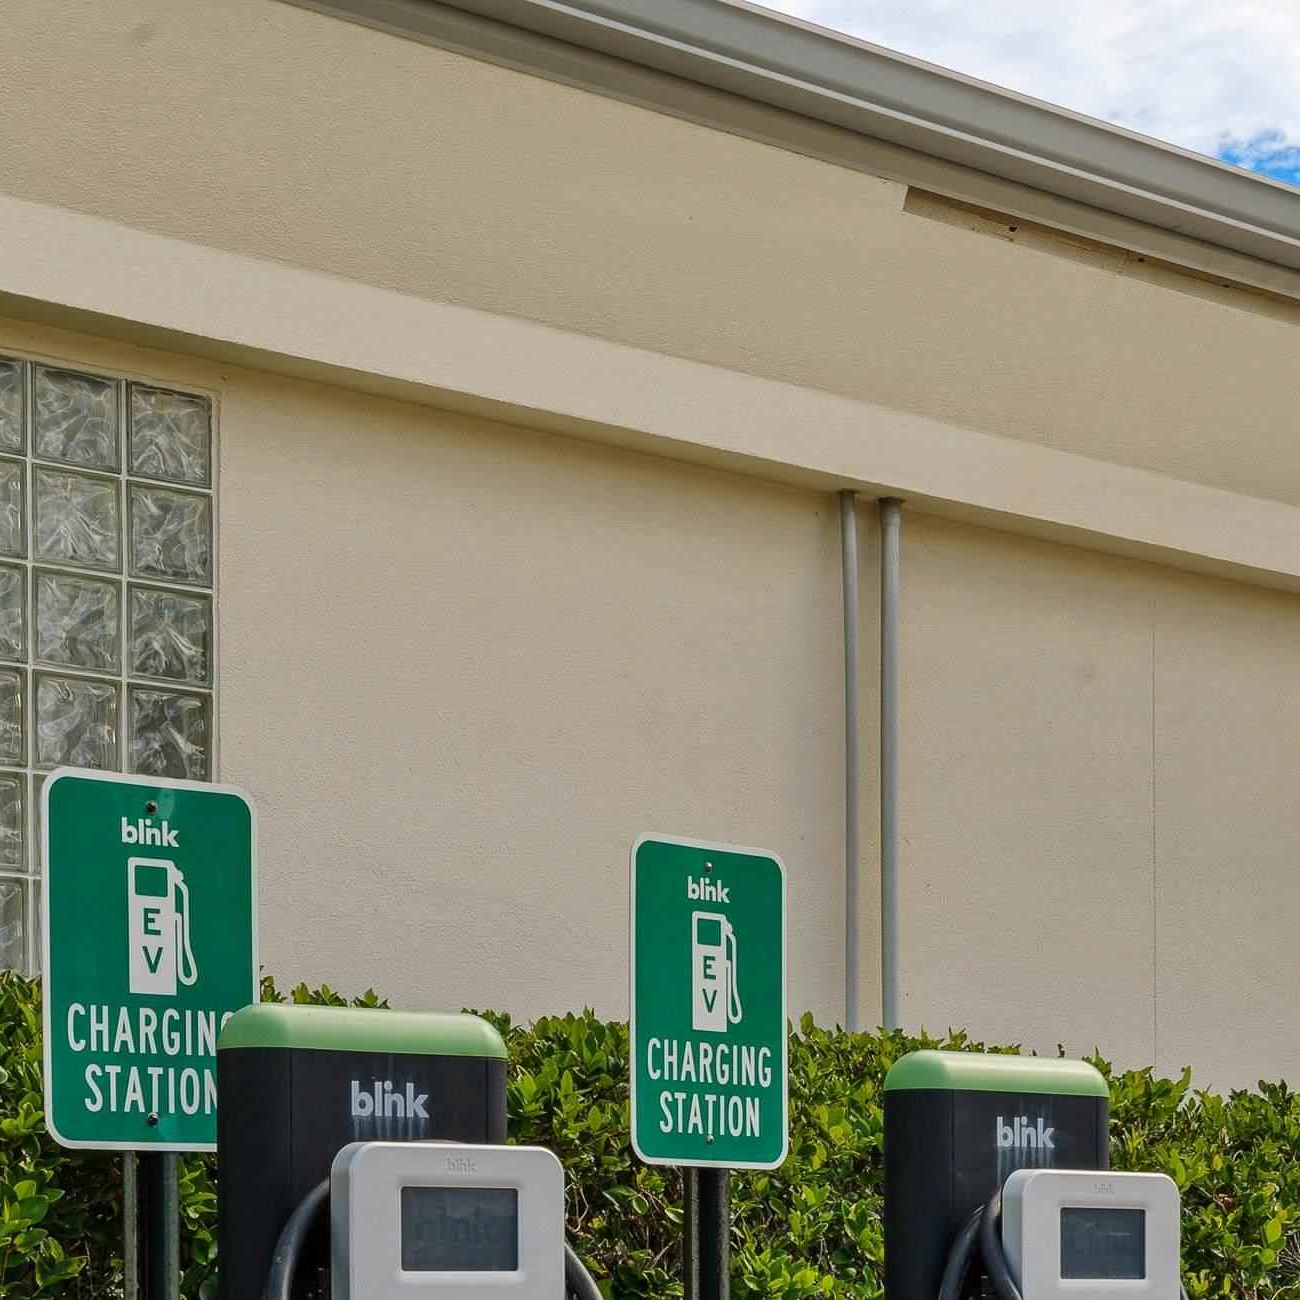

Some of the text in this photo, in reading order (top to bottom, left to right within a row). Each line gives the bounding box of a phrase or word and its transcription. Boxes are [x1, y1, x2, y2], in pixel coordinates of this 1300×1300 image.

[121, 816, 180, 848] blink
[687, 875, 731, 904] blink
[647, 1037, 772, 1088] CHARGING
[351, 1080, 430, 1119] blink
[659, 1090, 760, 1138] STATION
[996, 1115, 1056, 1149] blink
